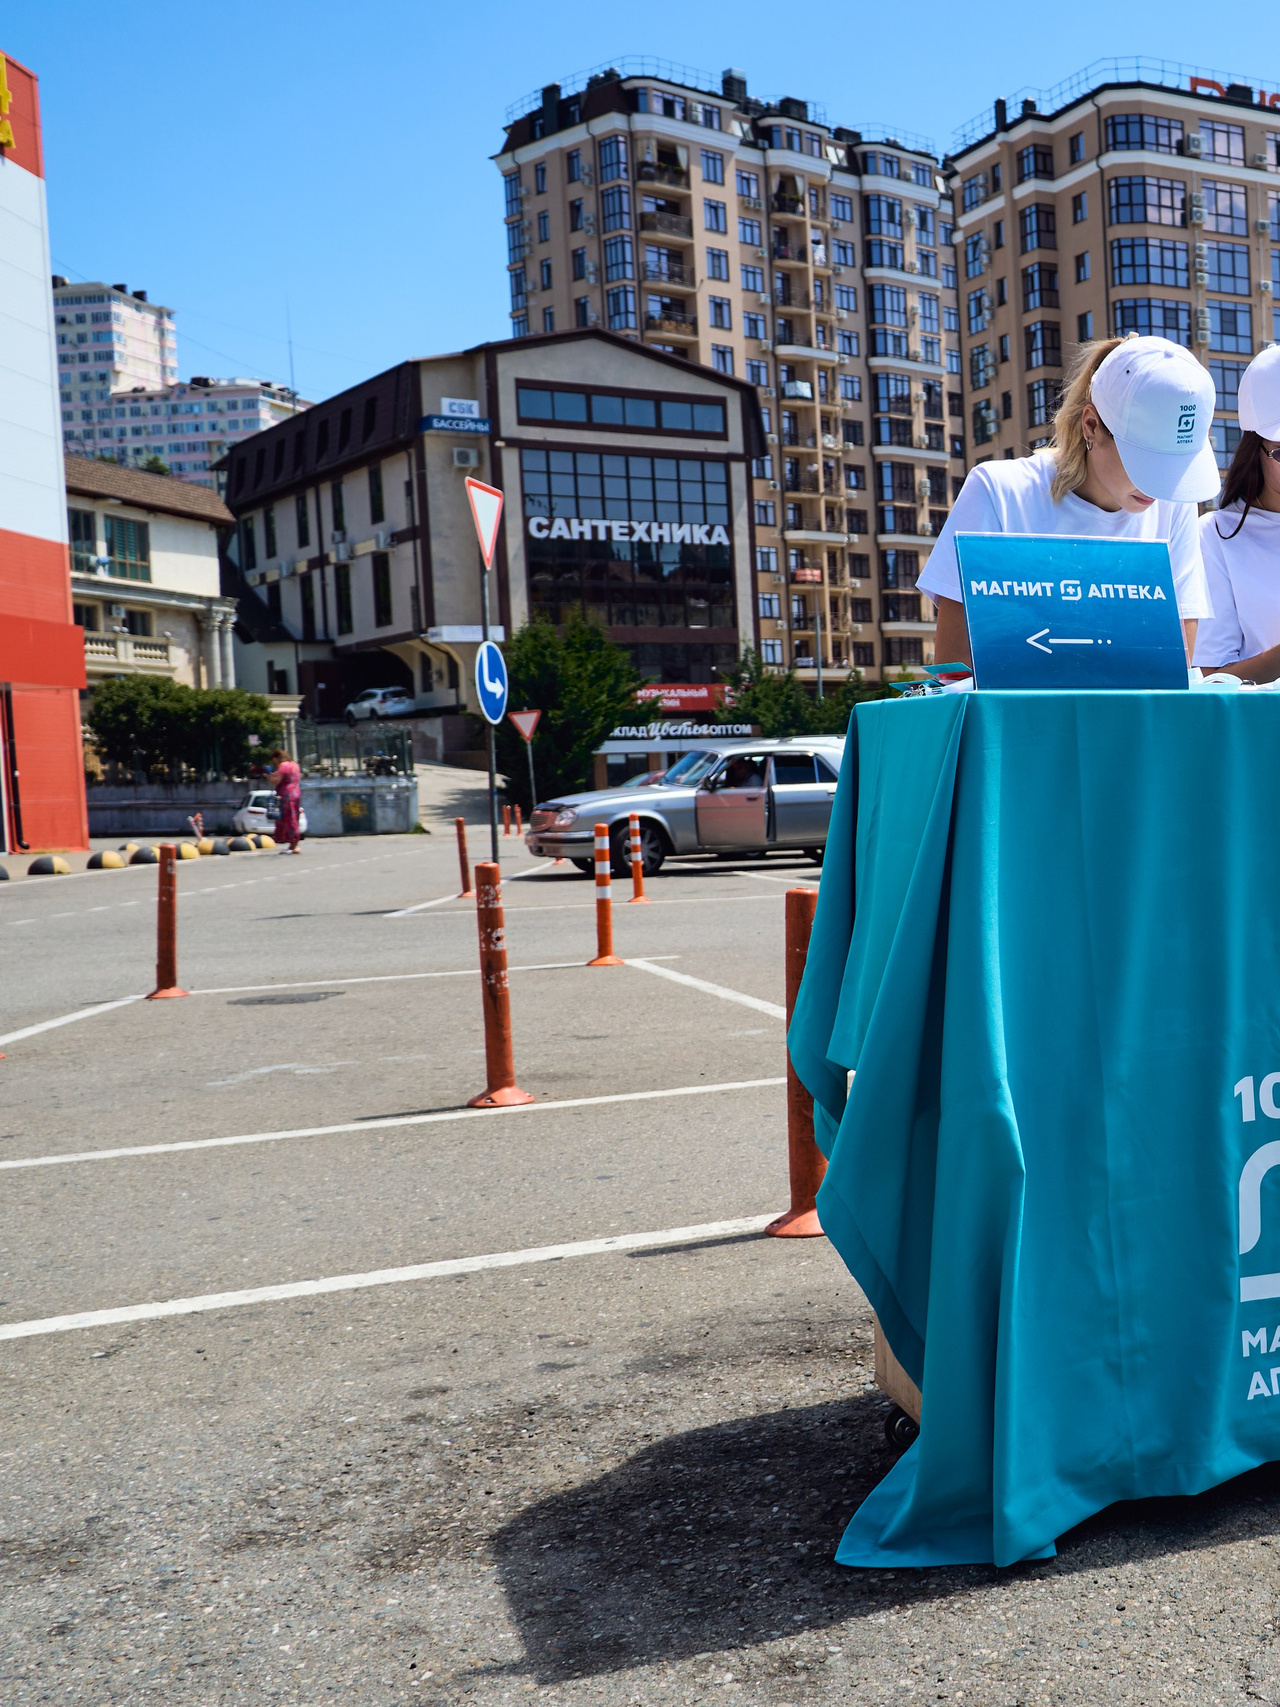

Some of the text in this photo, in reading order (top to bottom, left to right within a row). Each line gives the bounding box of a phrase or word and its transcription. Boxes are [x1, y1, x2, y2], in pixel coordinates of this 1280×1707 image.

[432, 418, 490, 432] БАССЕЙНЫ
[528, 516, 731, 545] САНТЕХНИКА
[970, 580, 1167, 600] МАГНИТ АПТЕКА
[609, 726, 647, 738] КЛАД
[709, 724, 753, 736] ОПТОМ
